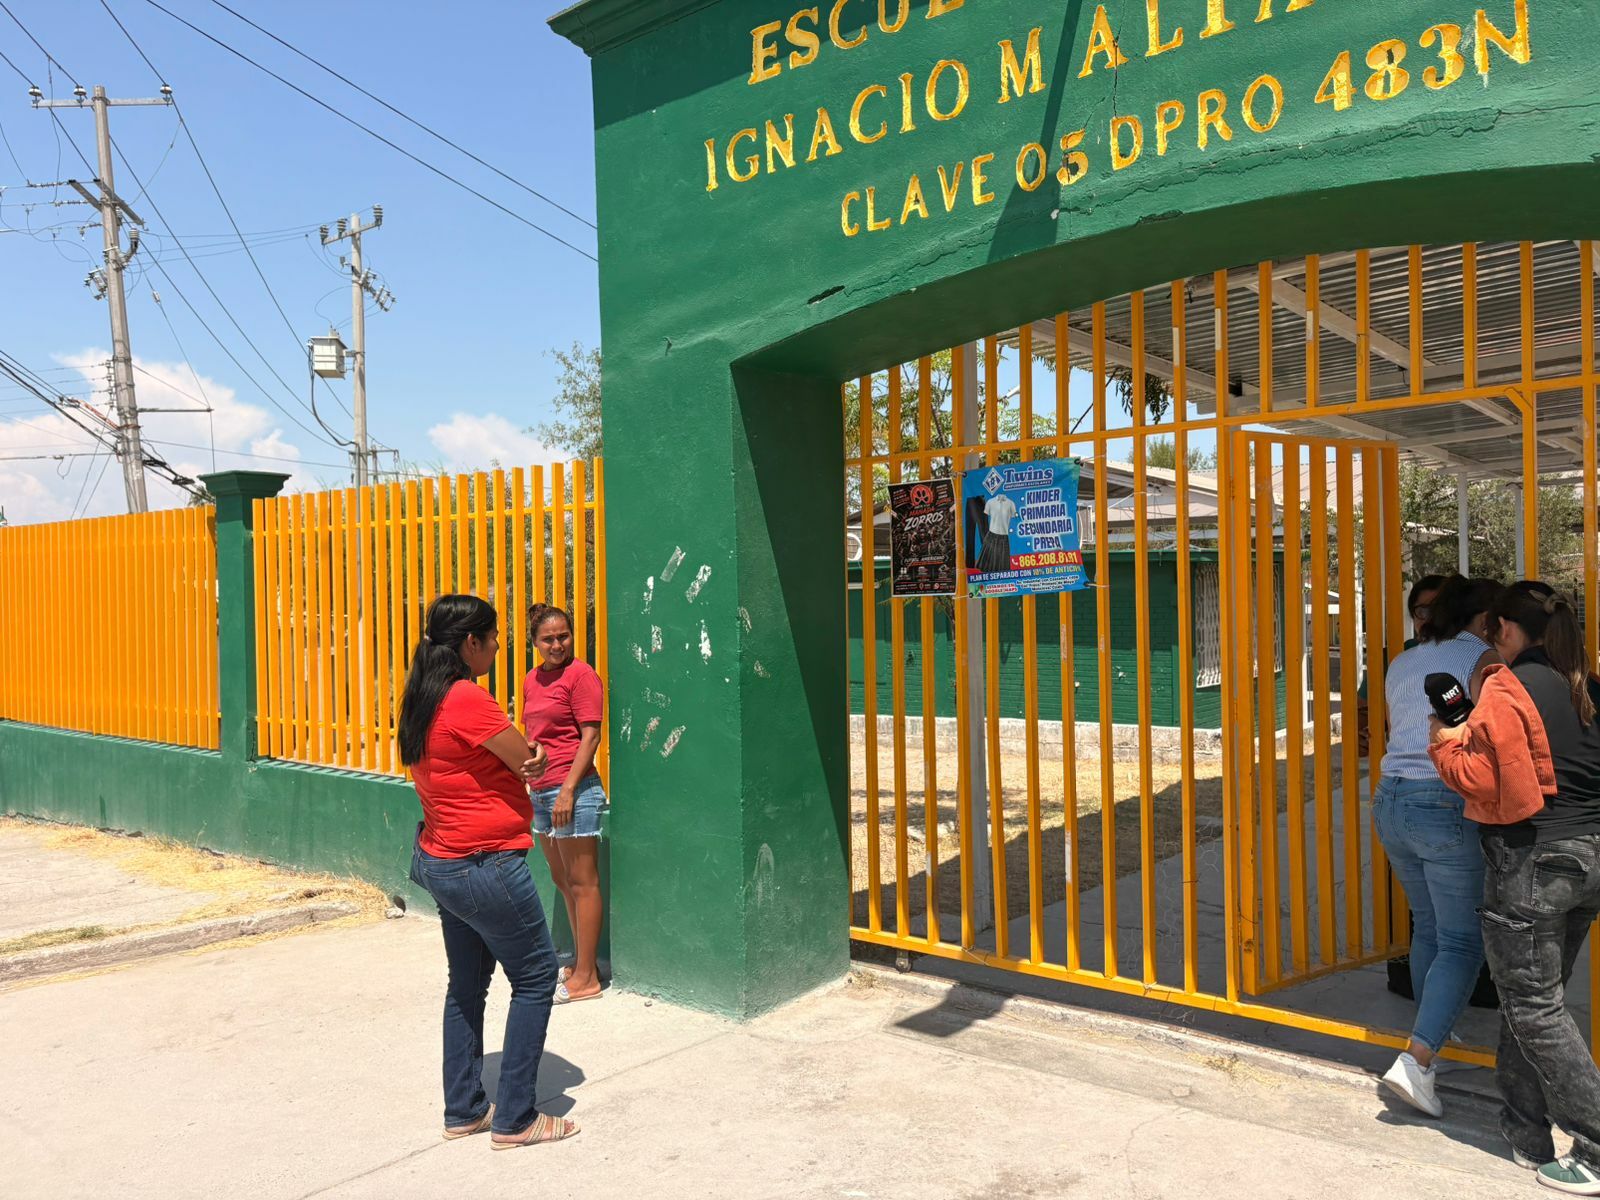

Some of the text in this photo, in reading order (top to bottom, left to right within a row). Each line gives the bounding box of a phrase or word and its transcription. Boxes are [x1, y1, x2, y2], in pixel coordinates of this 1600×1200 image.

[705, 59, 969, 192] IGNACIO
[997, 26, 1046, 104] M
[841, 153, 995, 236] CLAVE
[1004, 466, 1053, 484] Twins
[1026, 488, 1060, 505] KINDER
[904, 510, 944, 531] ZORROS
[1021, 503, 1066, 521] PRIMARIA
[1018, 519, 1073, 536] SECUNDARIA
[990, 570, 1019, 580] SEPARADO
[1020, 568, 1032, 577] CON
[1045, 566, 1054, 575] DE
[1441, 684, 1460, 702] NRT
